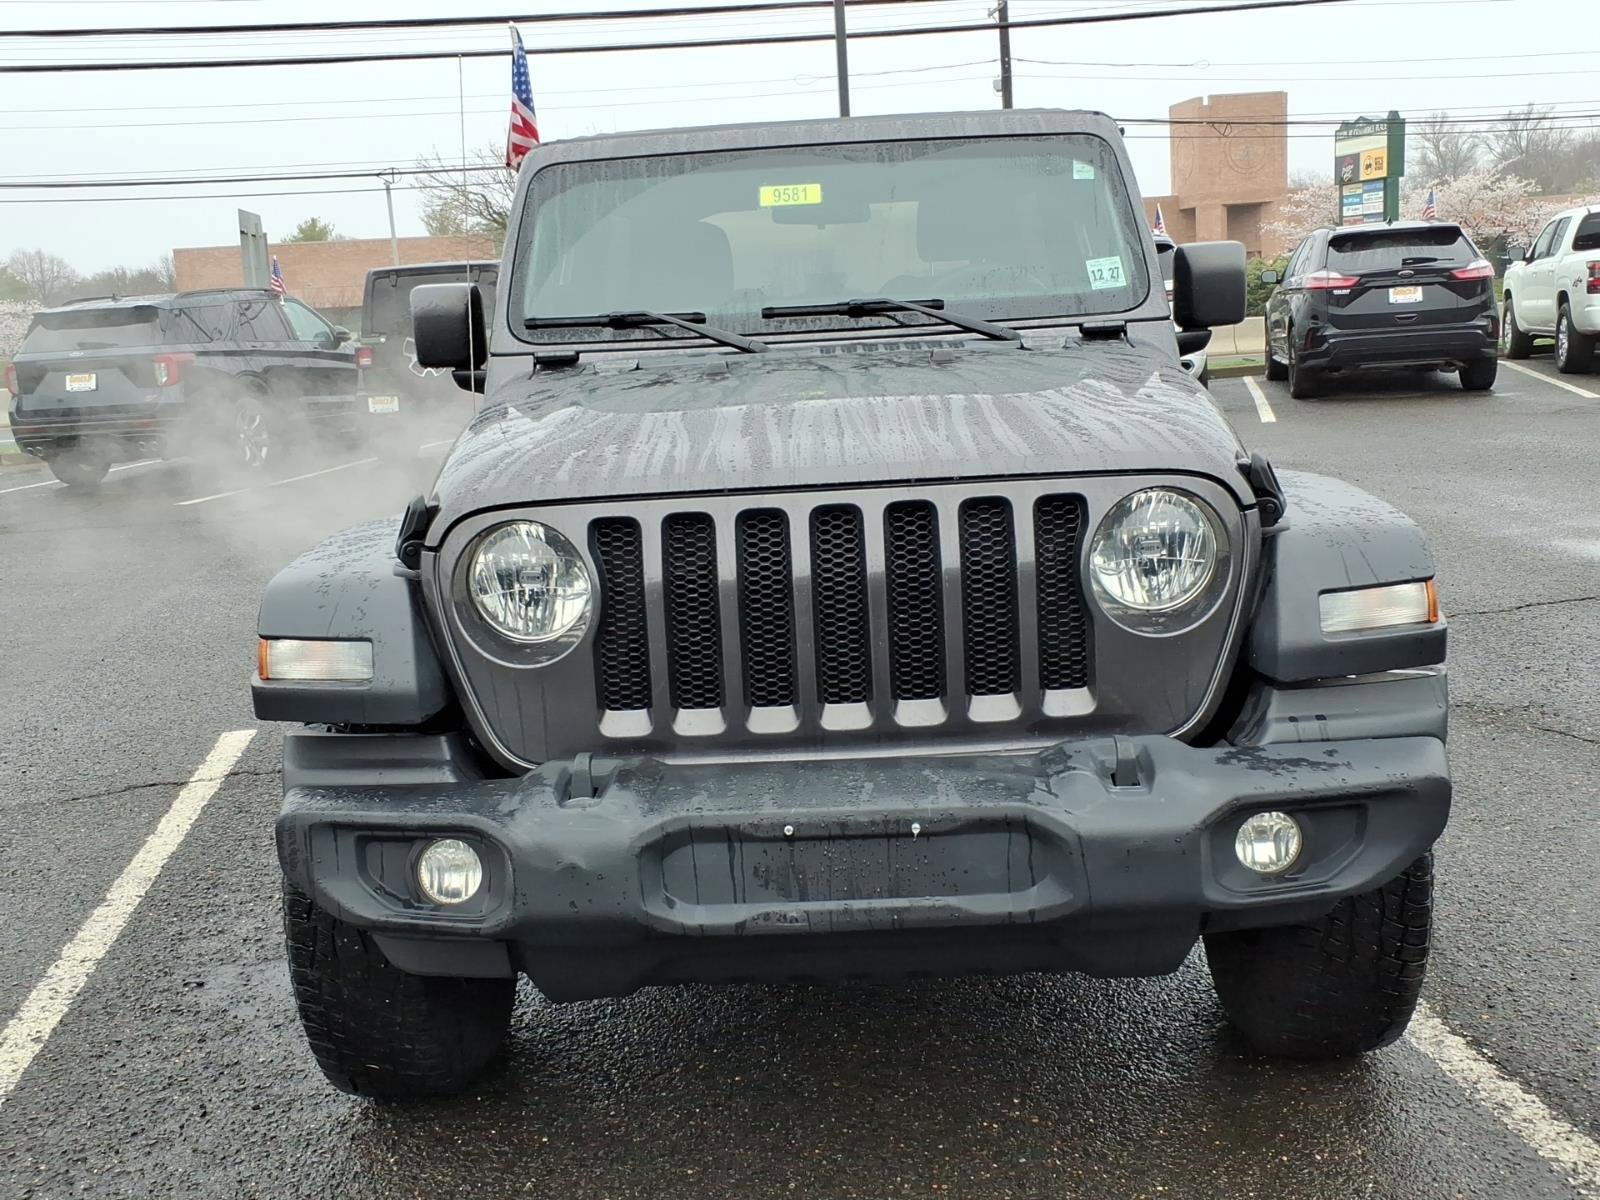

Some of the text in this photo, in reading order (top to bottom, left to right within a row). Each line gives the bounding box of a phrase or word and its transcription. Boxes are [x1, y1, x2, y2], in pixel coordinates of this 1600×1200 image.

[773, 186, 807, 203] 9581
[1091, 266, 1120, 281] 12 27
